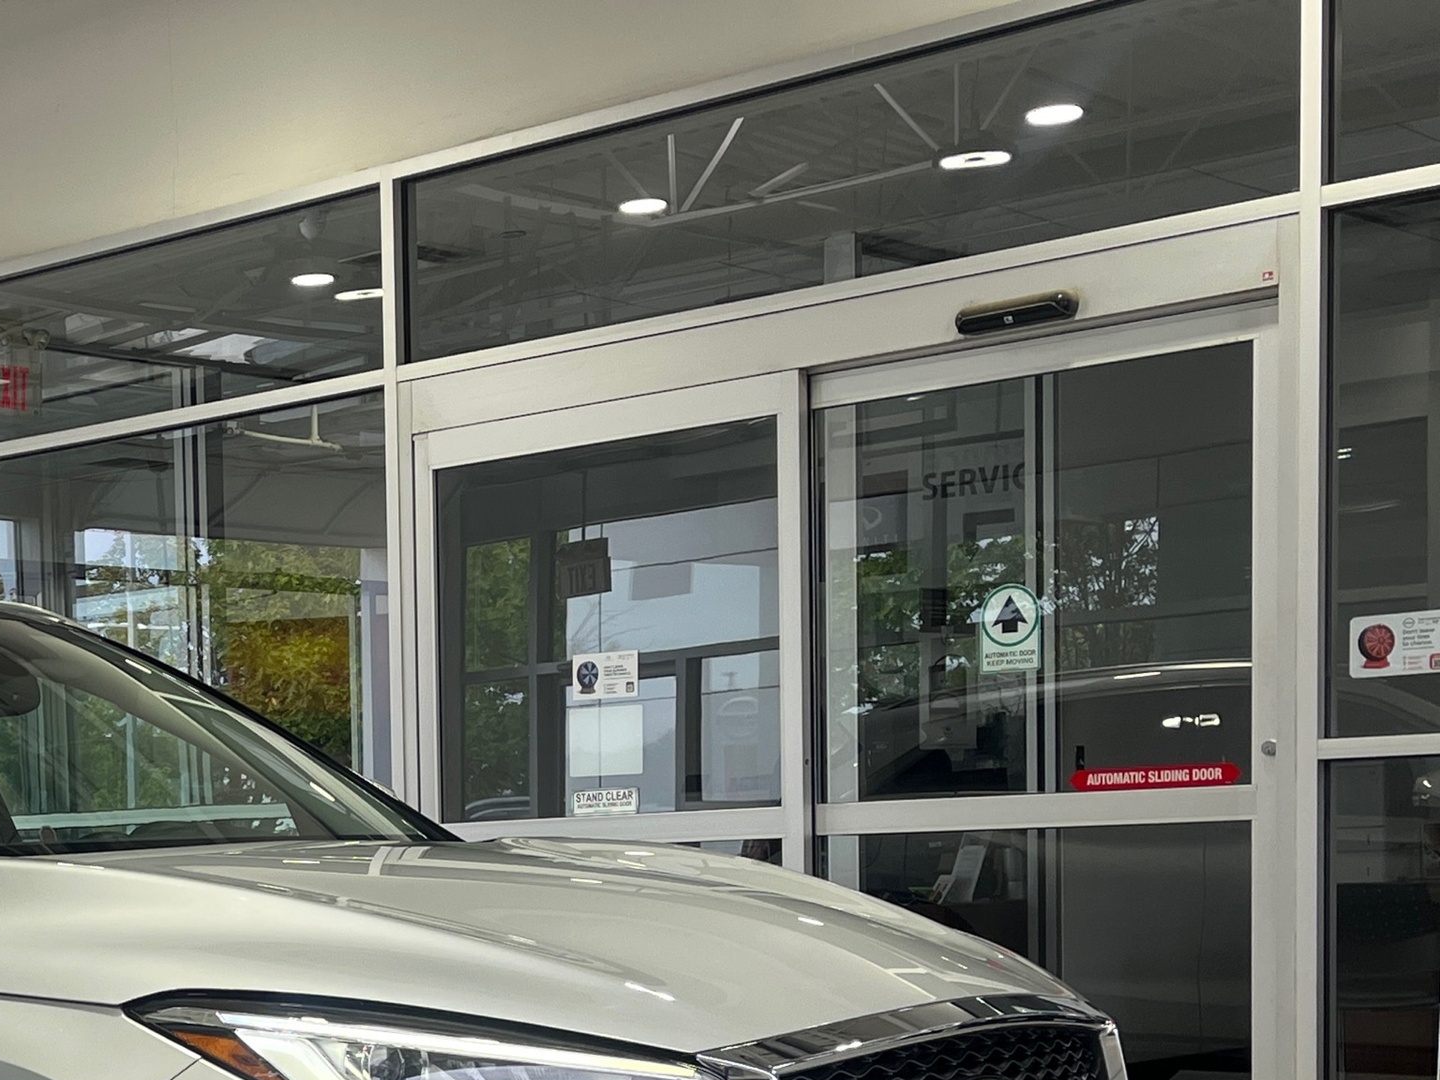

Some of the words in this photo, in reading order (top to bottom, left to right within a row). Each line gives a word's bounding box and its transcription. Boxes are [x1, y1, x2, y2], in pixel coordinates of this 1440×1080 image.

[985, 651, 1018, 659] AUTOMATIC
[1019, 649, 1036, 657] DOOR
[1006, 657, 1033, 665] MOVING
[1087, 771, 1146, 786] AUTOMATIC
[1148, 769, 1189, 783] SLIDING
[1192, 767, 1222, 781] DOOR
[575, 792, 603, 803] STAND
[605, 790, 634, 802] CLEAR
